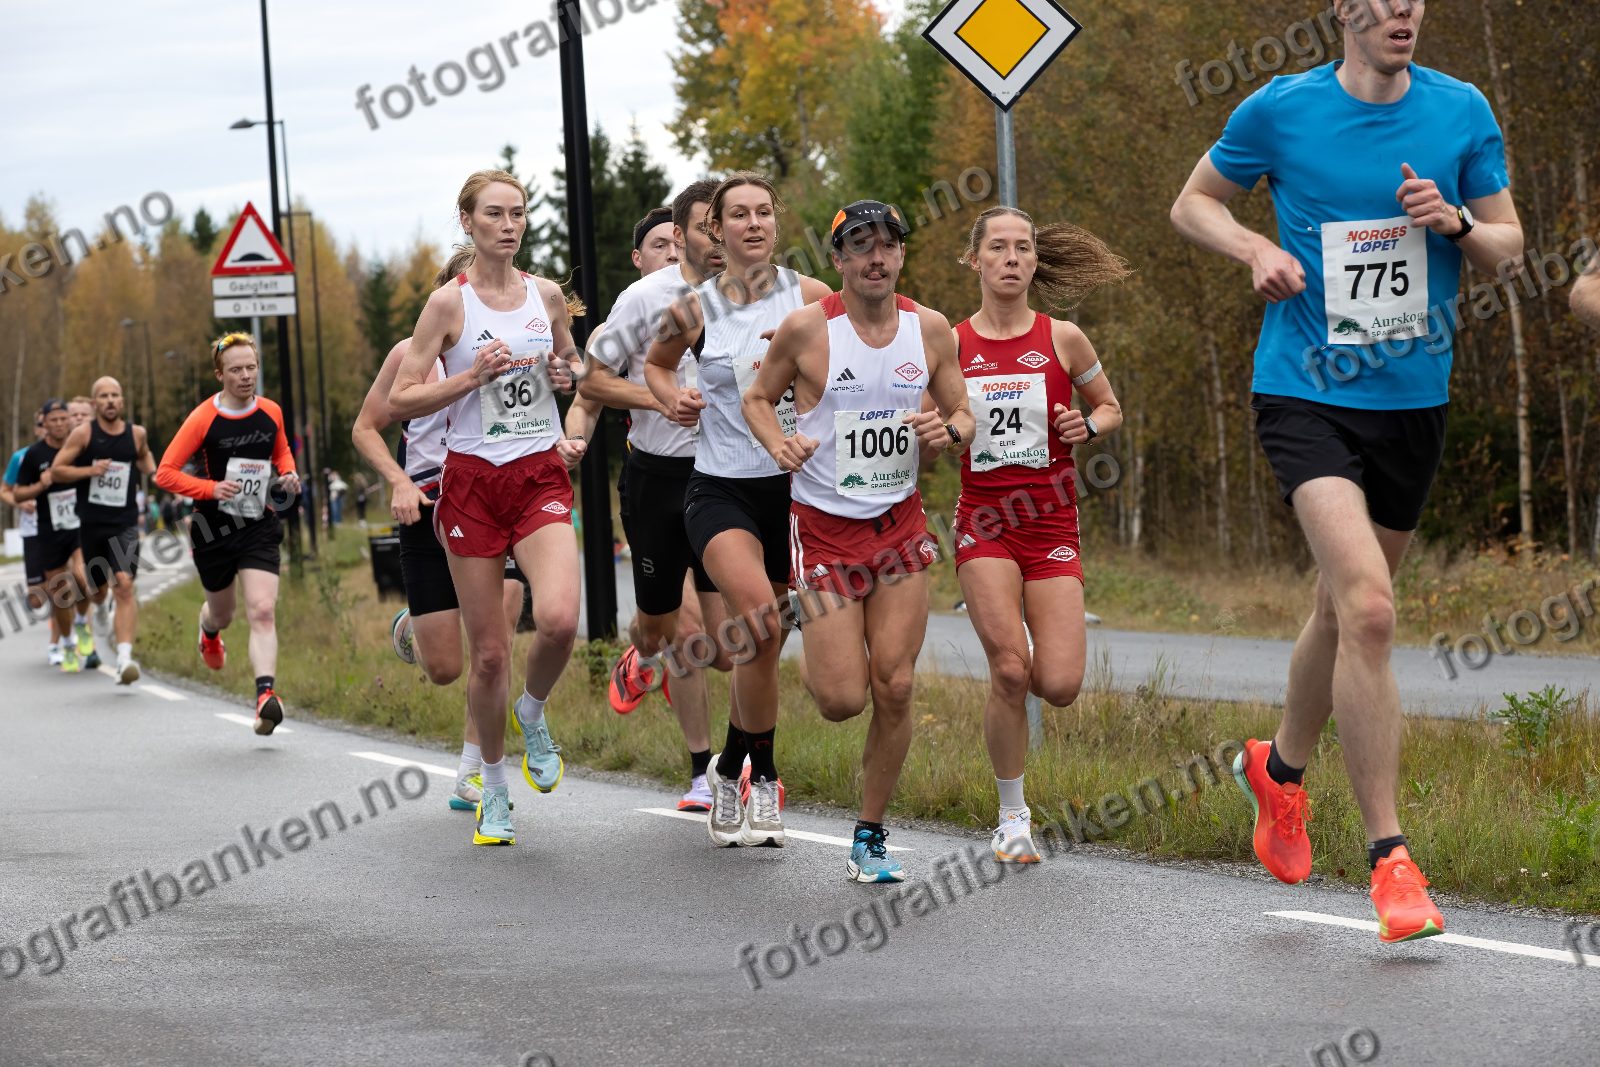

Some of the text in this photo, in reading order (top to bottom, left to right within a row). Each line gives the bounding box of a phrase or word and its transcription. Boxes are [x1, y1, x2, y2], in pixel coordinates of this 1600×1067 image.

[1347, 226, 1408, 242] NORGES
[1352, 239, 1399, 253] LØPET
[1344, 260, 1409, 300] 775
[233, 302, 241, 313] 0
[1371, 311, 1424, 329] Aurskog
[981, 381, 1031, 392] NORGES
[503, 380, 532, 409] 36
[985, 391, 1024, 401] LØPET
[859, 409, 897, 421] LØPET
[989, 407, 1023, 436] 24
[514, 417, 551, 430] Aurskog
[844, 425, 910, 459] 1006
[1001, 447, 1047, 460] Aurskog
[98, 475, 121, 489] 640
[870, 469, 911, 482] Aurskog
